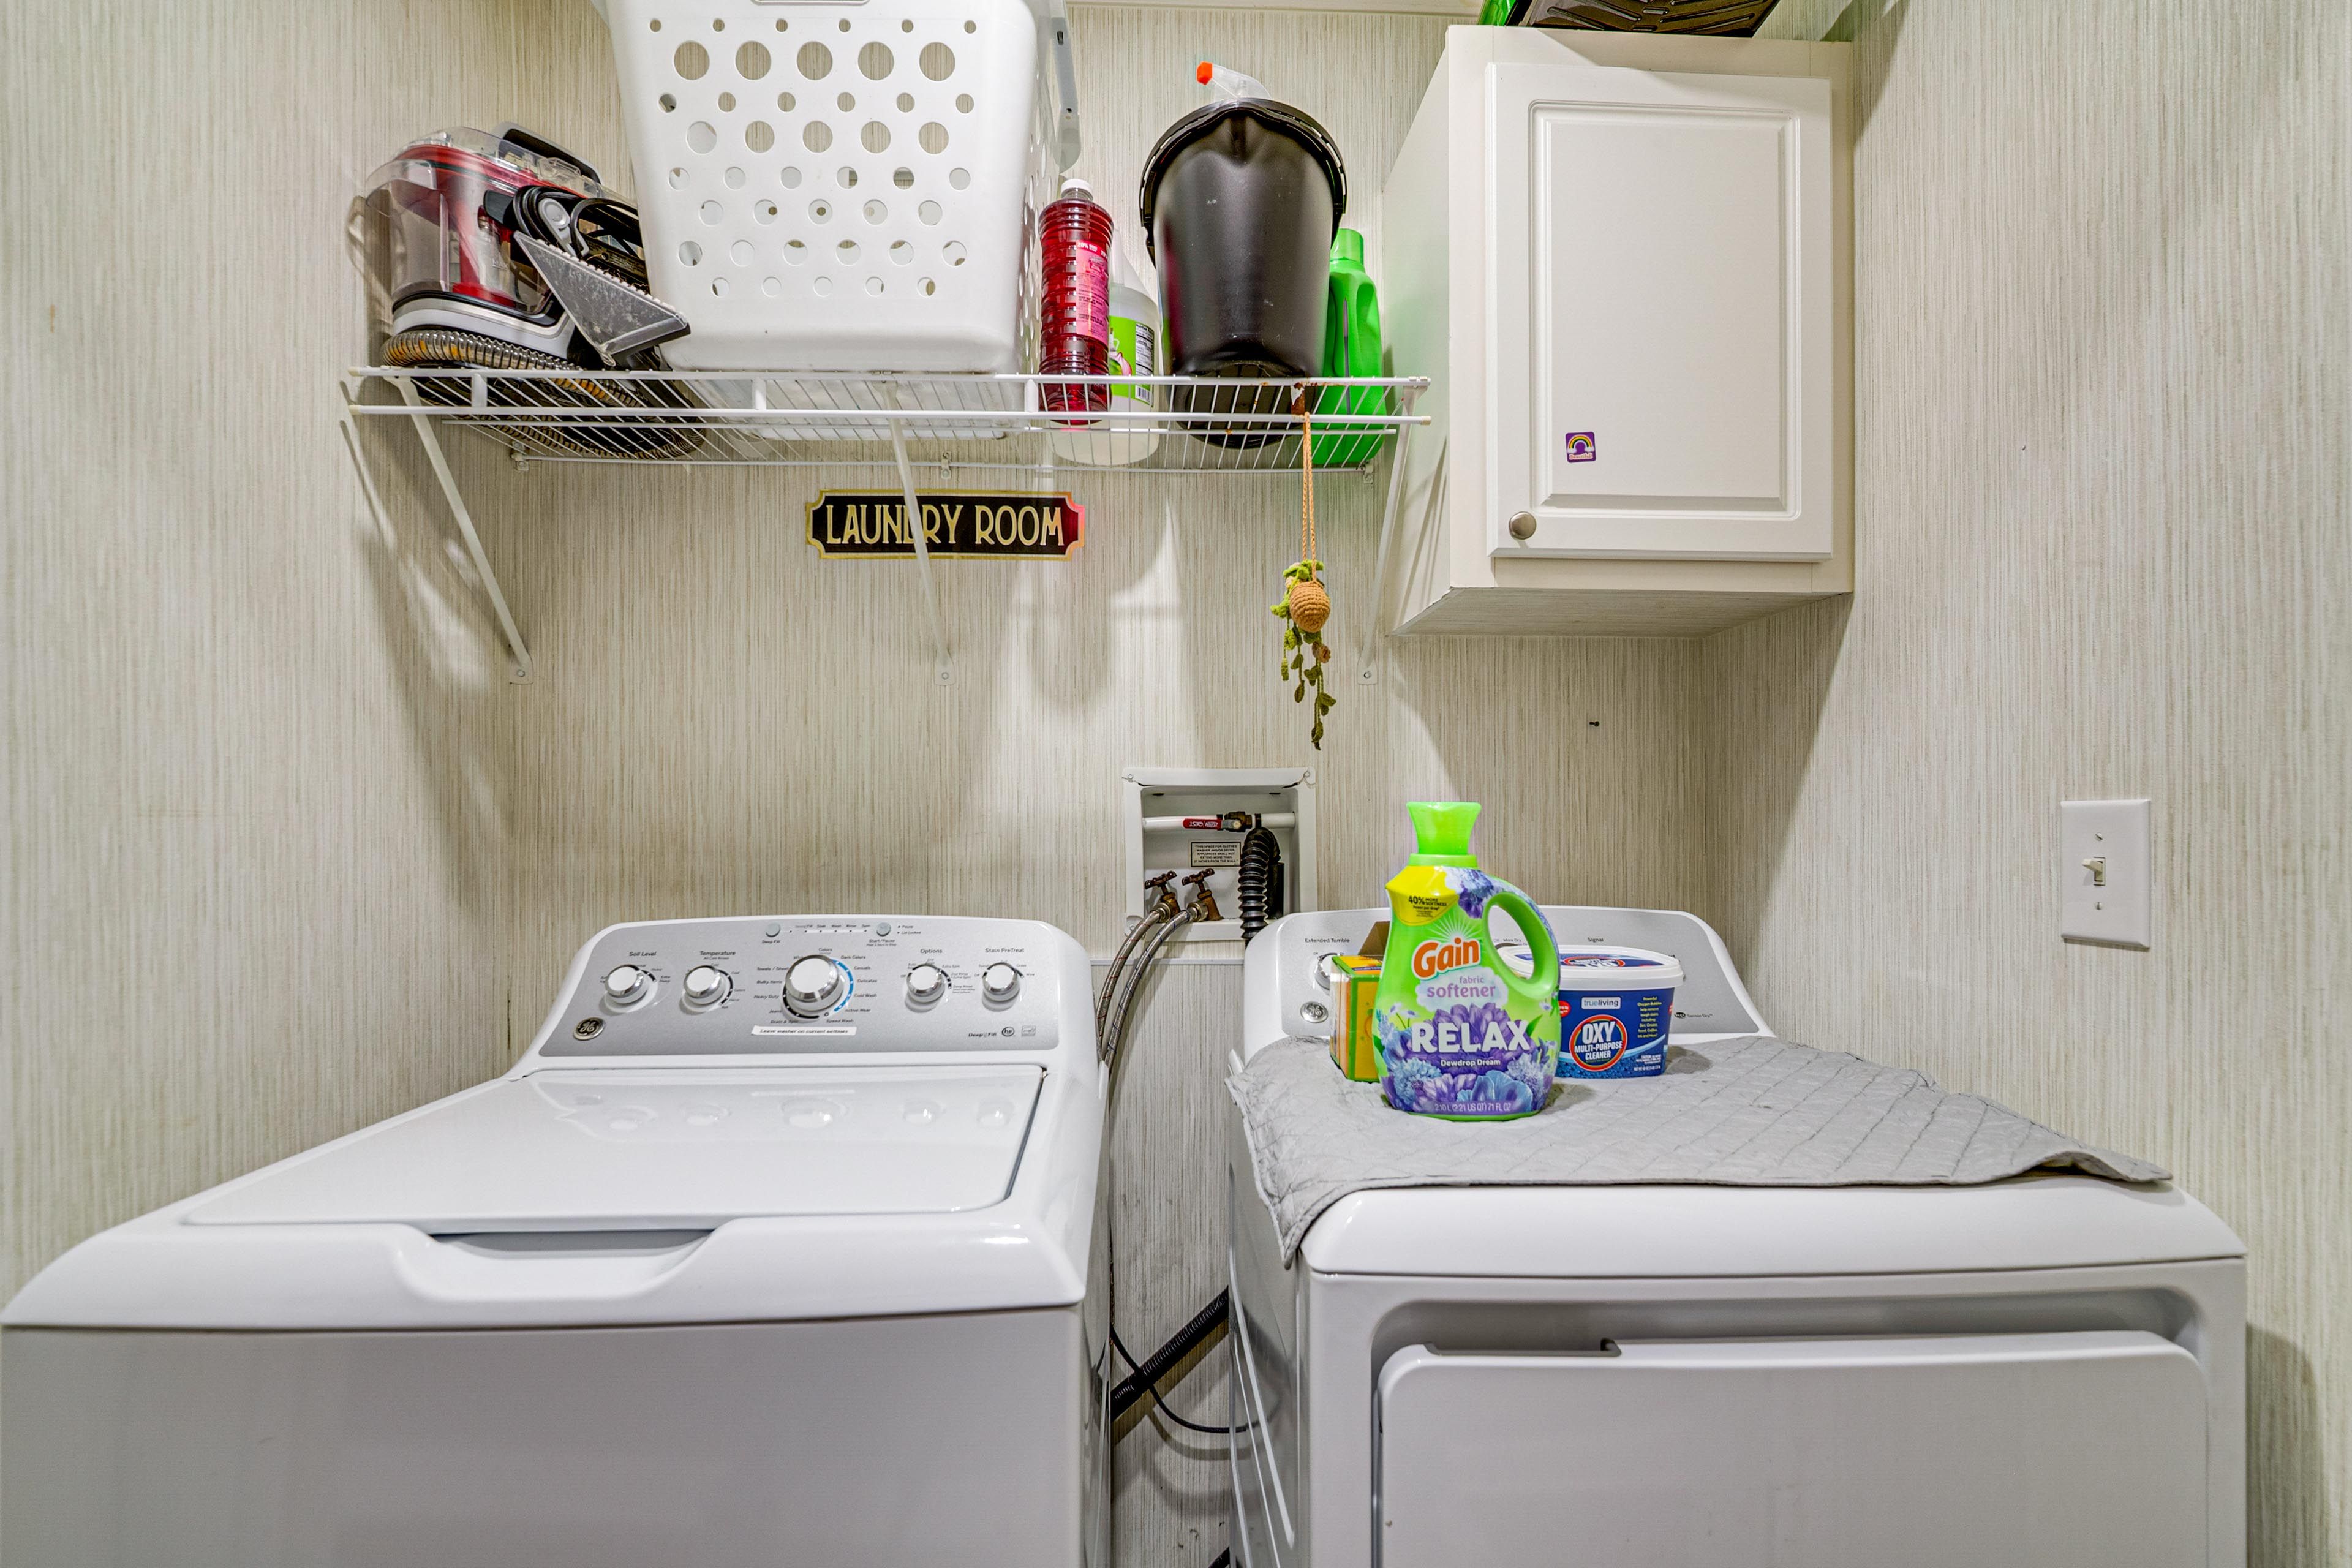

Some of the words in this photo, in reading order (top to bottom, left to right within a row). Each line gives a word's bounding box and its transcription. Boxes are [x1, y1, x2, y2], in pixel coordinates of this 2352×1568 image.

[975, 505, 1063, 546] ROOM
[1408, 895, 1425, 905] 40%
[1412, 937, 1480, 978] Gain
[1427, 983, 1496, 998] softener
[1411, 1020, 1531, 1054] RELAX
[1582, 1021, 1616, 1044] OXY
[1574, 1041, 1623, 1053] MULTI-PURPOSE
[1585, 1050, 1611, 1060] CLEANER
[1468, 1103, 1476, 1112] US
[1488, 1103, 1494, 1112] 71
